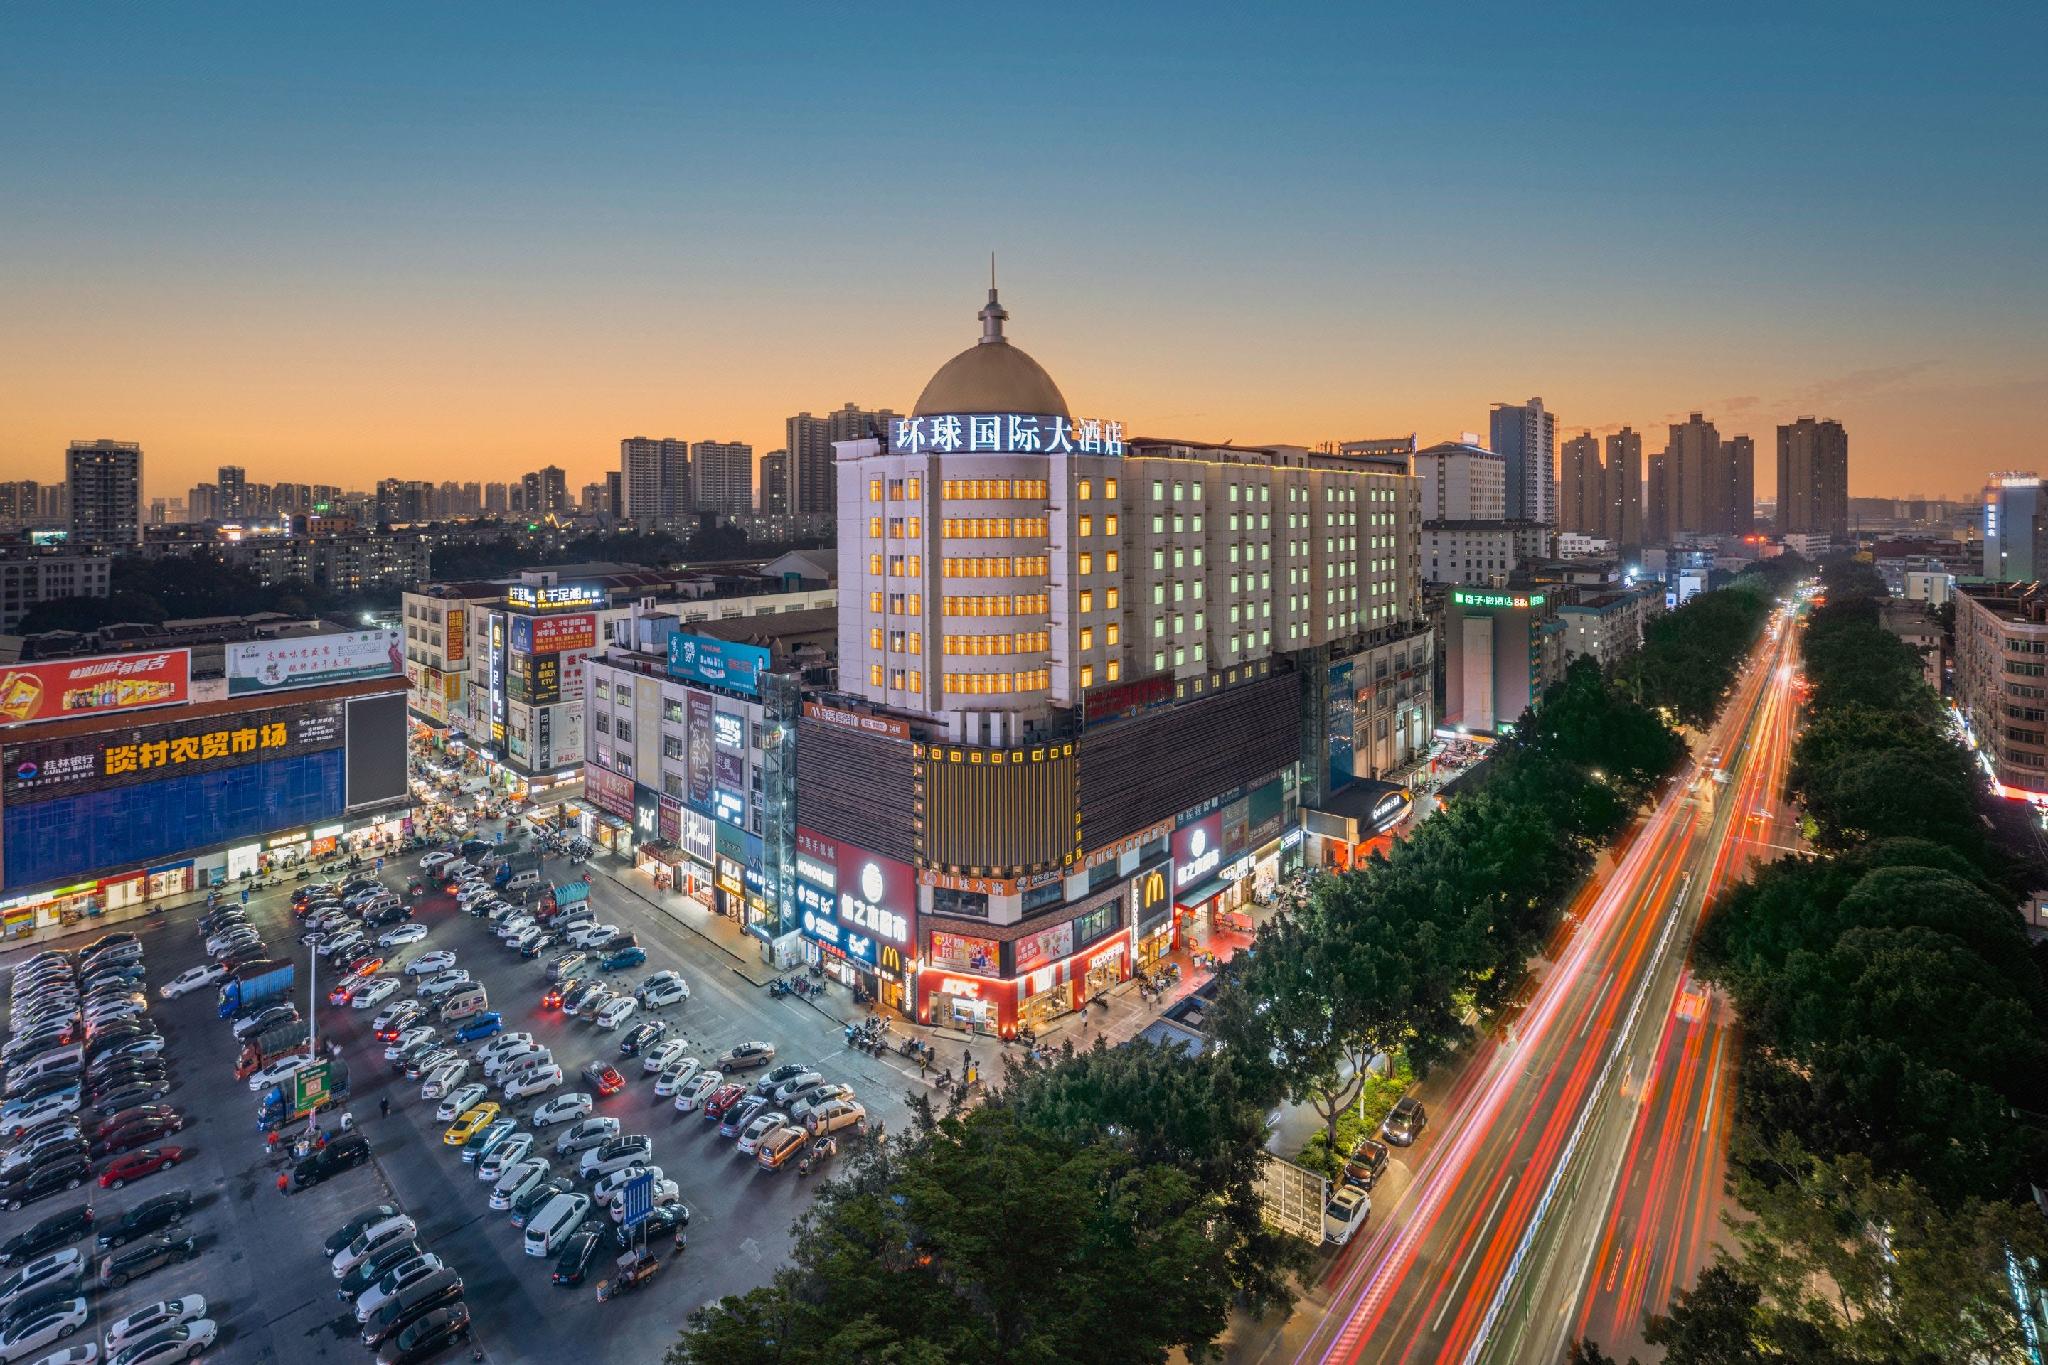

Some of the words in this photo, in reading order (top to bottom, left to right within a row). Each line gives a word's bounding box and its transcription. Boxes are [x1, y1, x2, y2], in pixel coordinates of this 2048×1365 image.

[896, 414, 1122, 455] 环球国际大酒店
[44, 754, 95, 770] 桂林银行
[105, 722, 286, 775] 淡村农贸市场
[44, 767, 71, 775] GUILIN
[73, 763, 95, 771] BANK
